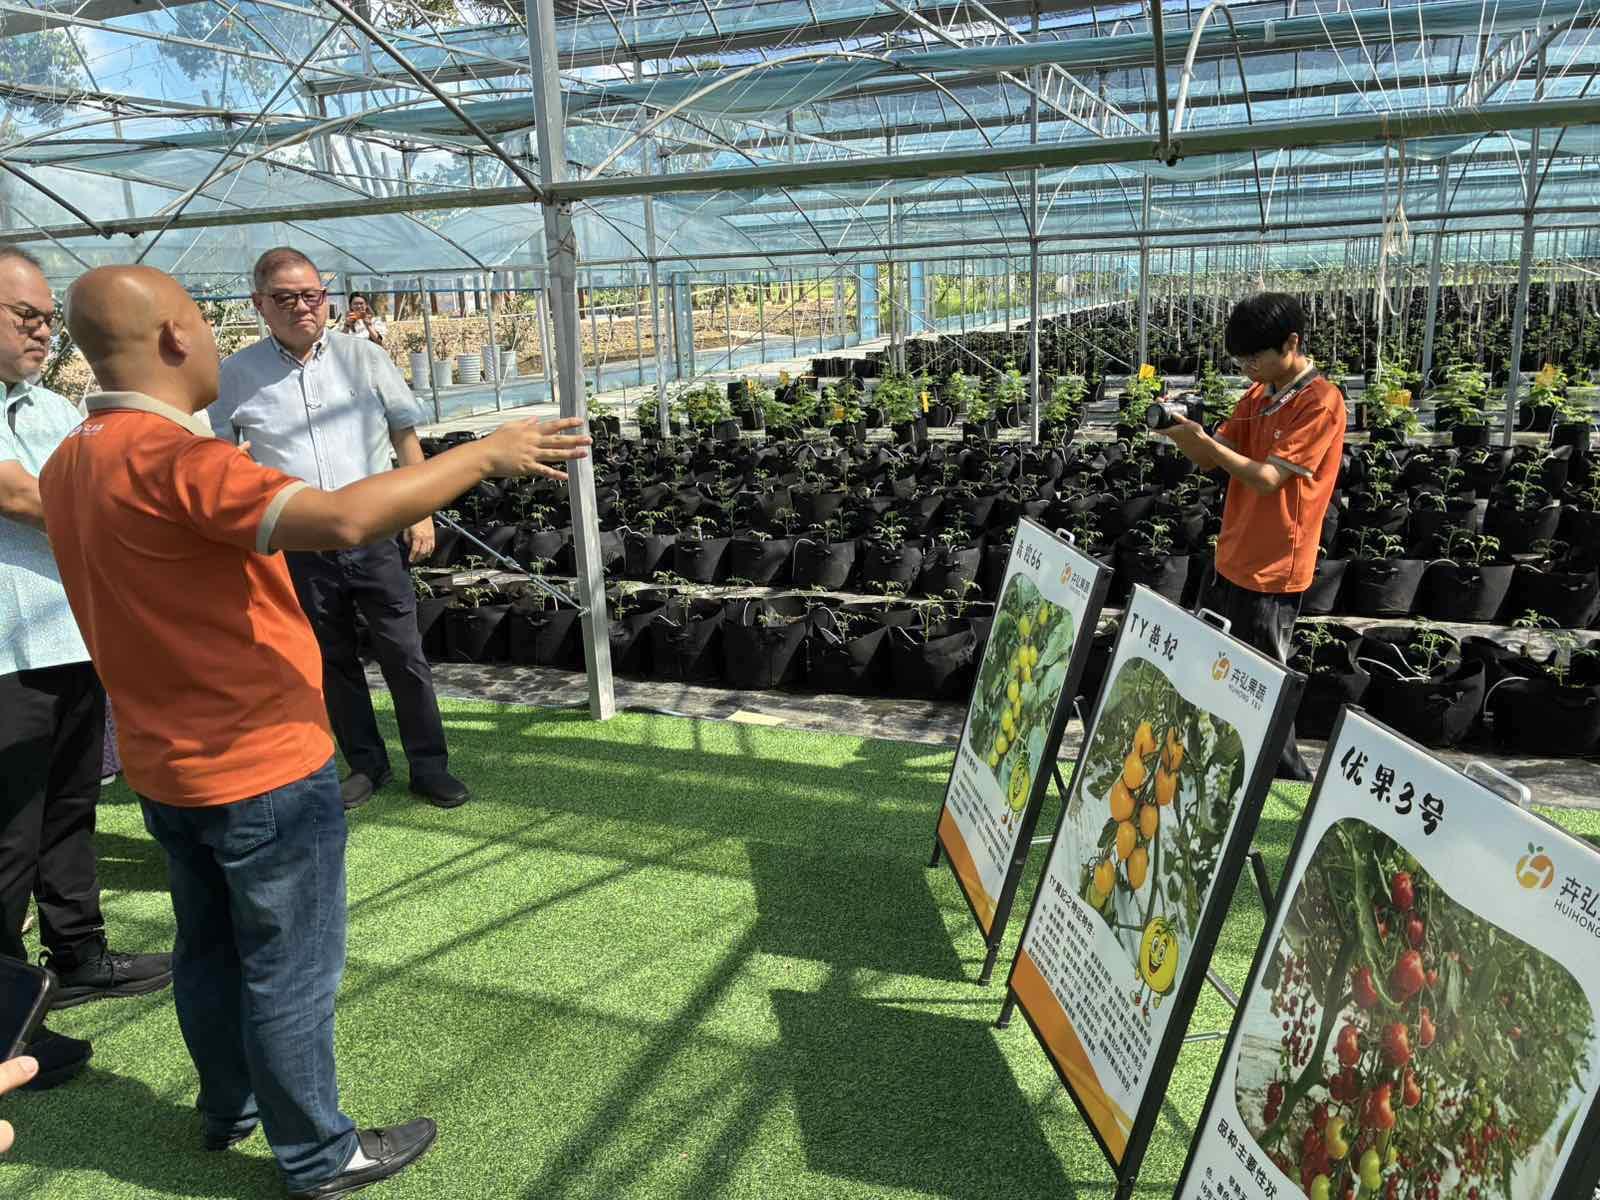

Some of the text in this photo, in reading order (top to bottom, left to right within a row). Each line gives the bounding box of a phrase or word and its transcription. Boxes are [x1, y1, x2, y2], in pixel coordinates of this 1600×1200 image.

[1341, 746, 1444, 835] 优果3号
[1560, 877, 1600, 921] 卉弘
[1217, 1118, 1277, 1200] 品种主要性状
